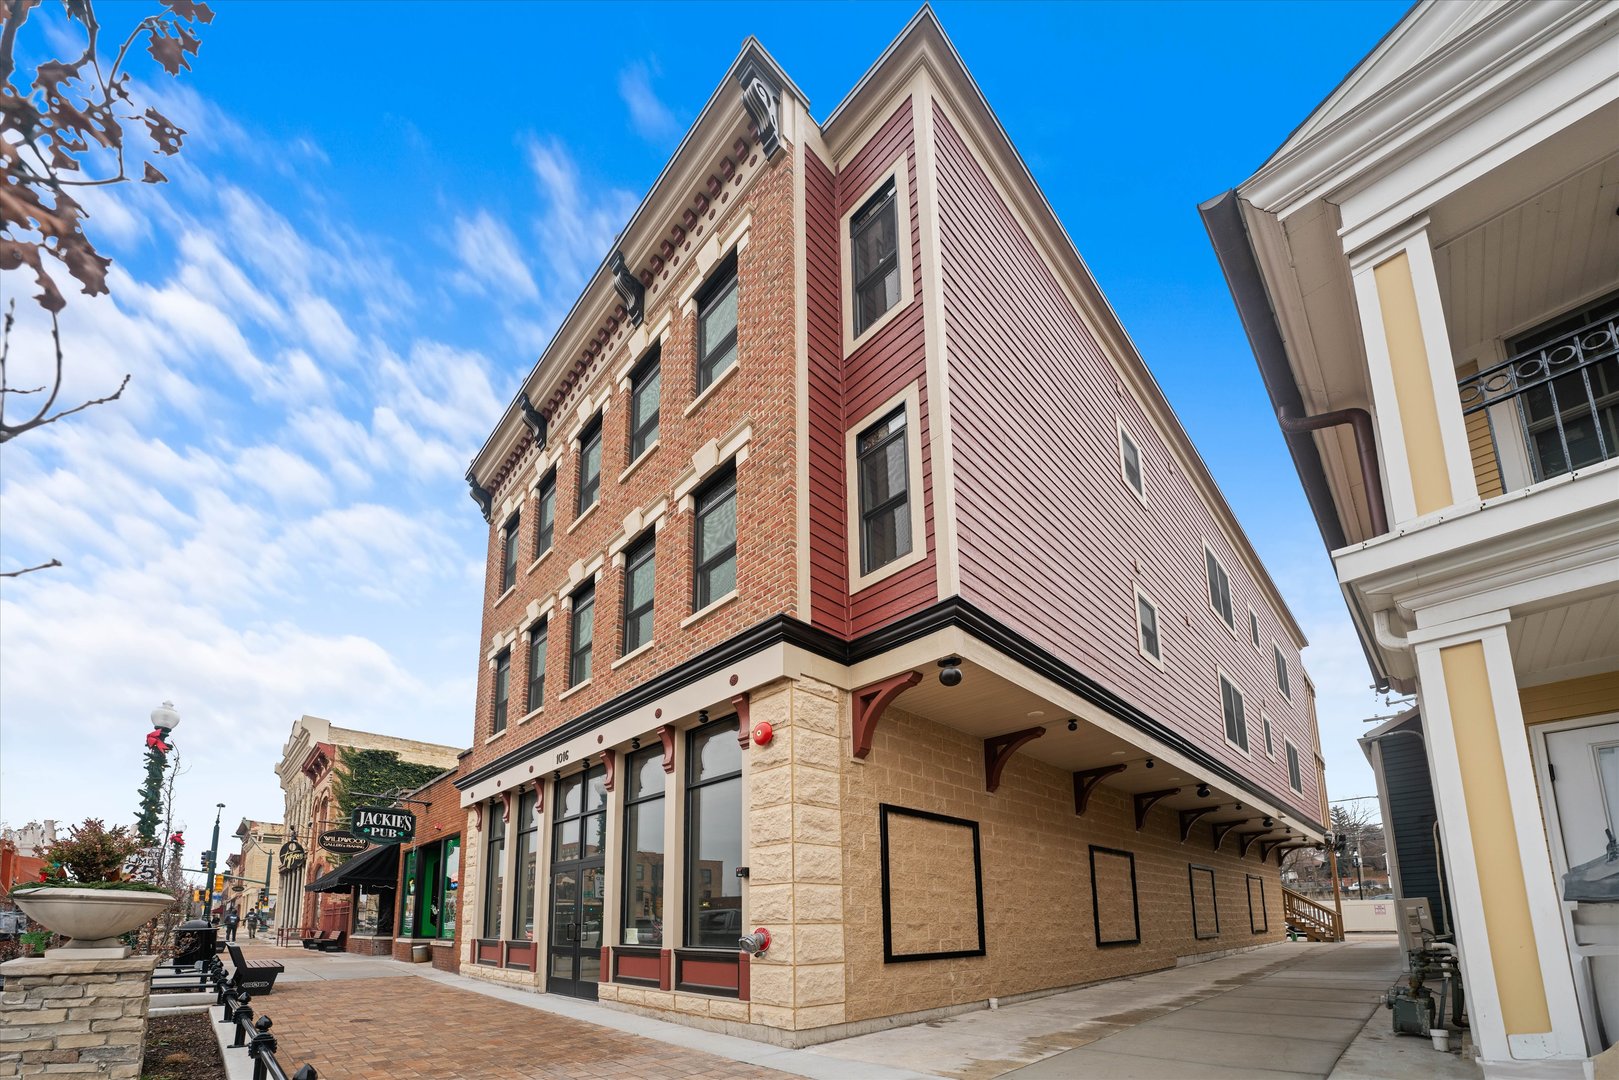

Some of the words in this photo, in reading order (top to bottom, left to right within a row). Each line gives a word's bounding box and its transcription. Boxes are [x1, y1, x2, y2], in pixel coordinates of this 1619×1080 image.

[556, 750, 569, 764] 1016
[356, 811, 412, 831] JACKIE'S
[371, 827, 397, 838] PUB
[323, 835, 366, 844] WILDWOOD
